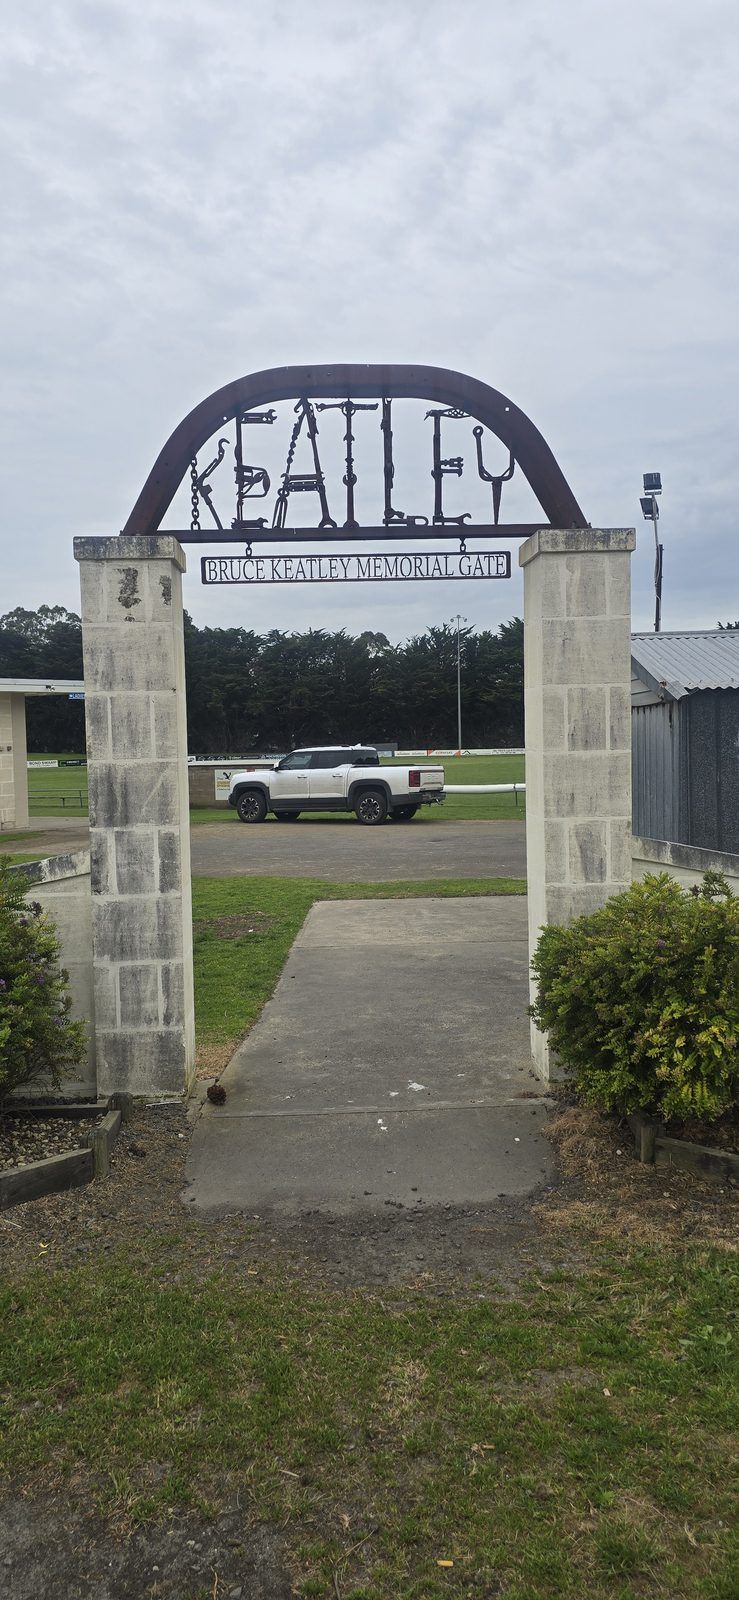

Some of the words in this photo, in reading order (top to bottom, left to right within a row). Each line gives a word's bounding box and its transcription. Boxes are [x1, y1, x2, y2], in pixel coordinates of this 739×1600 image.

[190, 398, 515, 530] KEATLEY
[207, 559, 266, 581] BRUCE
[270, 558, 351, 580] KEATLEY
[356, 556, 454, 579] MEMORIAL
[459, 555, 506, 577] GATE
